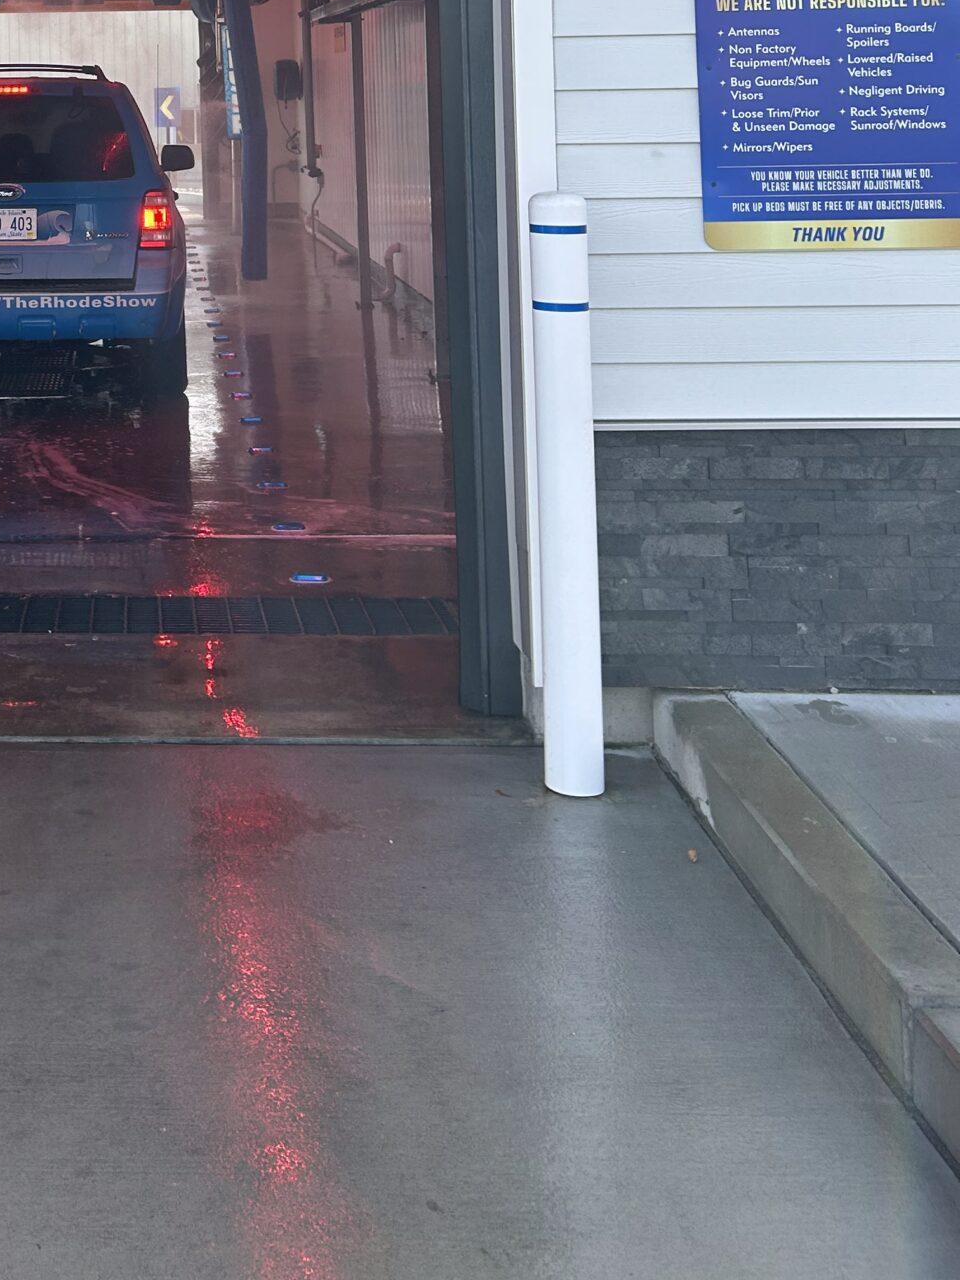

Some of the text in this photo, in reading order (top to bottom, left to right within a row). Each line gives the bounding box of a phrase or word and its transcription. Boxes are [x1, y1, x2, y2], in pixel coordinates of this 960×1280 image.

[727, 26, 780, 37] Antennas
[846, 21, 937, 35] Running Boards/
[729, 43, 796, 55] Non Factory
[846, 37, 890, 49] Spoilers
[729, 56, 831, 69] Equipment/Wheels
[847, 52, 934, 64] Lowered/Raised
[847, 67, 892, 77] Vehicles
[730, 75, 819, 89] Bug Guards/Sun
[730, 90, 764, 101] Visors
[848, 84, 945, 97] Negligent Driving
[731, 107, 820, 119] Loose Trim/Prior
[850, 105, 929, 119] Rack Systems/
[732, 120, 836, 133] & Unseen Damage
[850, 119, 947, 131] Sunroof/Windows
[732, 141, 813, 154] Mirrors/Wipers
[751, 168, 934, 181] YOU KNOW YOUR VEHICLE BETTER THAN WE DO.
[761, 179, 924, 192] PLEASE MAKE NECESSARY ADJUSTMENTS.
[732, 199, 946, 212] PICK UP BEDS MUST BE FREE OF ANY OBJECTS/DEBRIS.
[10, 216, 33, 232] 403
[792, 226, 885, 242] THANK YOU
